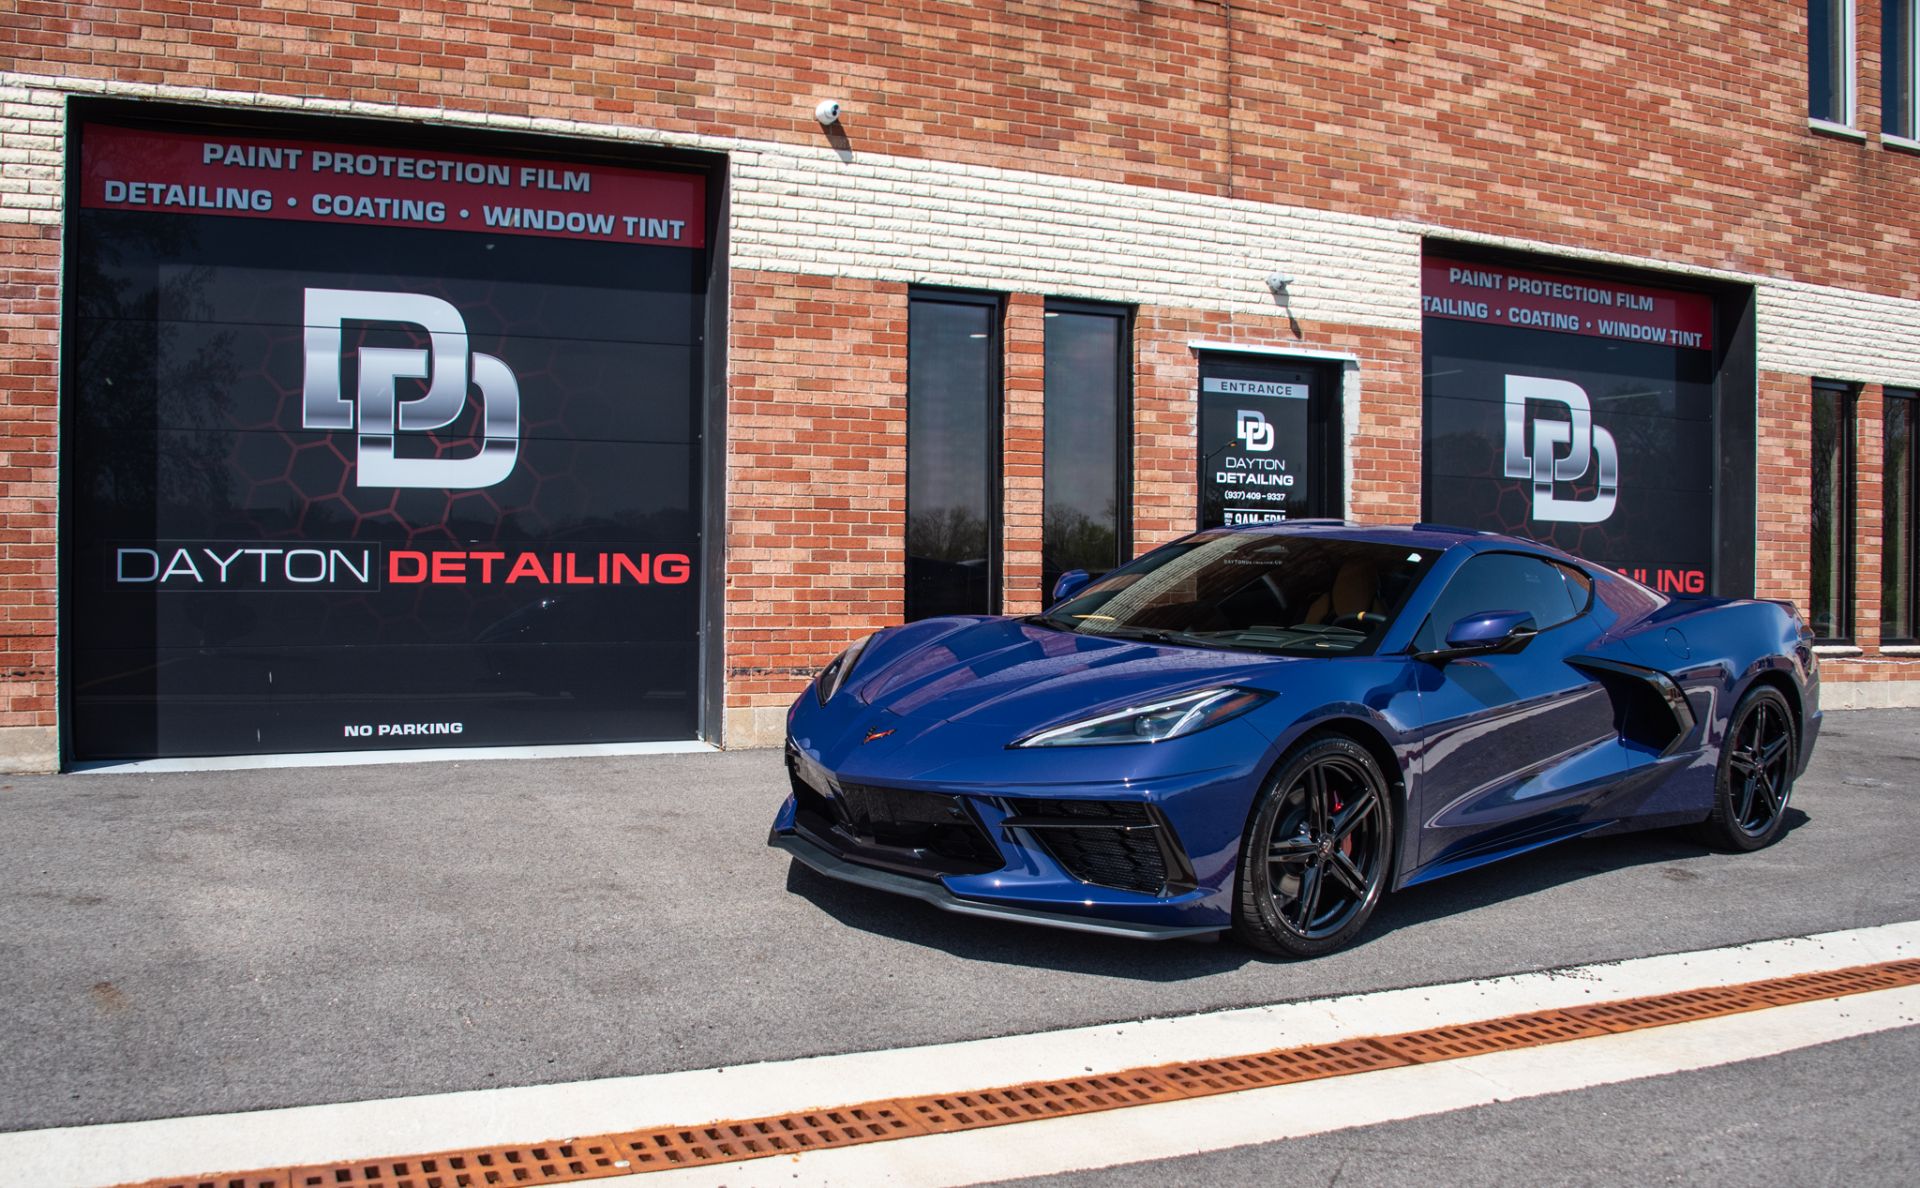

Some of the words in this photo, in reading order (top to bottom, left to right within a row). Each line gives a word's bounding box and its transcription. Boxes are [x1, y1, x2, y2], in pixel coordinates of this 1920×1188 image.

[203, 143, 303, 170] PAINT
[312, 150, 510, 186] PROTECTION
[520, 167, 591, 192] FILM
[104, 180, 272, 211] DETAILING
[312, 193, 446, 222] COATING
[483, 204, 615, 236] WINDOW
[622, 216, 685, 241] TINT
[1450, 267, 1503, 290] PAINT
[1507, 276, 1612, 306] PROTECTION
[1616, 292, 1654, 312] FILM
[1422, 295, 1488, 319] TAILING
[1508, 307, 1579, 331] COATING
[1598, 319, 1667, 343] WINDOW
[1669, 329, 1703, 348] TINT
[1220, 381, 1293, 396] ENTRANCE
[1216, 471, 1294, 486] DETAILING
[1225, 456, 1286, 471] DAYTON
[117, 548, 369, 584] DAYTON
[388, 550, 691, 585] DETAILING
[344, 725, 373, 737] NO
[378, 722, 463, 736] PARKING
